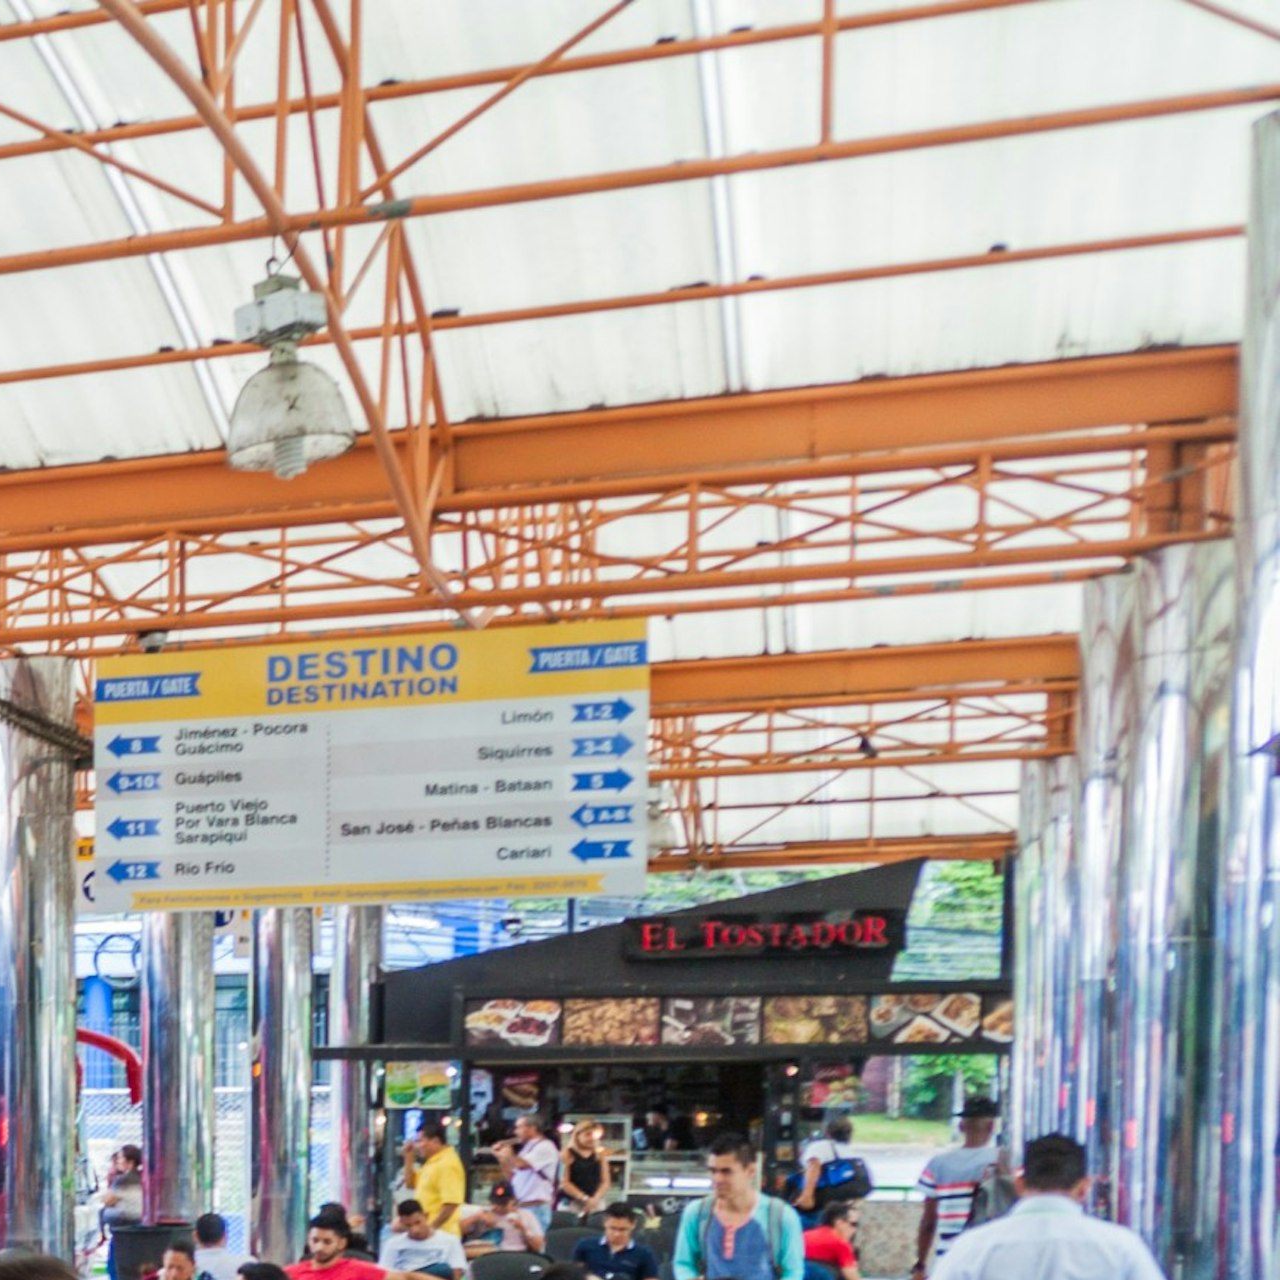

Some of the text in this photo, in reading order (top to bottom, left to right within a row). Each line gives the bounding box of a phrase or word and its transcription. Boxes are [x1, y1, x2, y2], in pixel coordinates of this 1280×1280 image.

[267, 643, 458, 683] DESTINO
[539, 649, 588, 669] PUERTA
[603, 645, 638, 664] GATE
[104, 680, 149, 698] PUERTA
[160, 677, 191, 694] GATE
[267, 676, 458, 706] DESTINATION
[501, 709, 553, 725] Limón
[584, 704, 613, 719] 1-2
[175, 726, 238, 742] Jiménez
[253, 722, 308, 737] Pocora
[175, 741, 244, 756] Guácimo
[478, 745, 553, 762] Siquirres
[175, 771, 243, 787] Guápiles
[591, 775, 603, 788] 5
[424, 782, 478, 797] Matina
[495, 778, 552, 793] Bataan
[175, 799, 268, 815] Puerto Viejo
[125, 822, 147, 835] 11
[175, 813, 298, 830] Por Vara Blanca
[340, 822, 371, 837] San
[376, 819, 414, 834] José
[430, 816, 480, 832] Peñas
[485, 814, 552, 830] Blancas
[496, 846, 552, 861] Cariari
[601, 842, 616, 858] 7
[125, 865, 147, 879] 12
